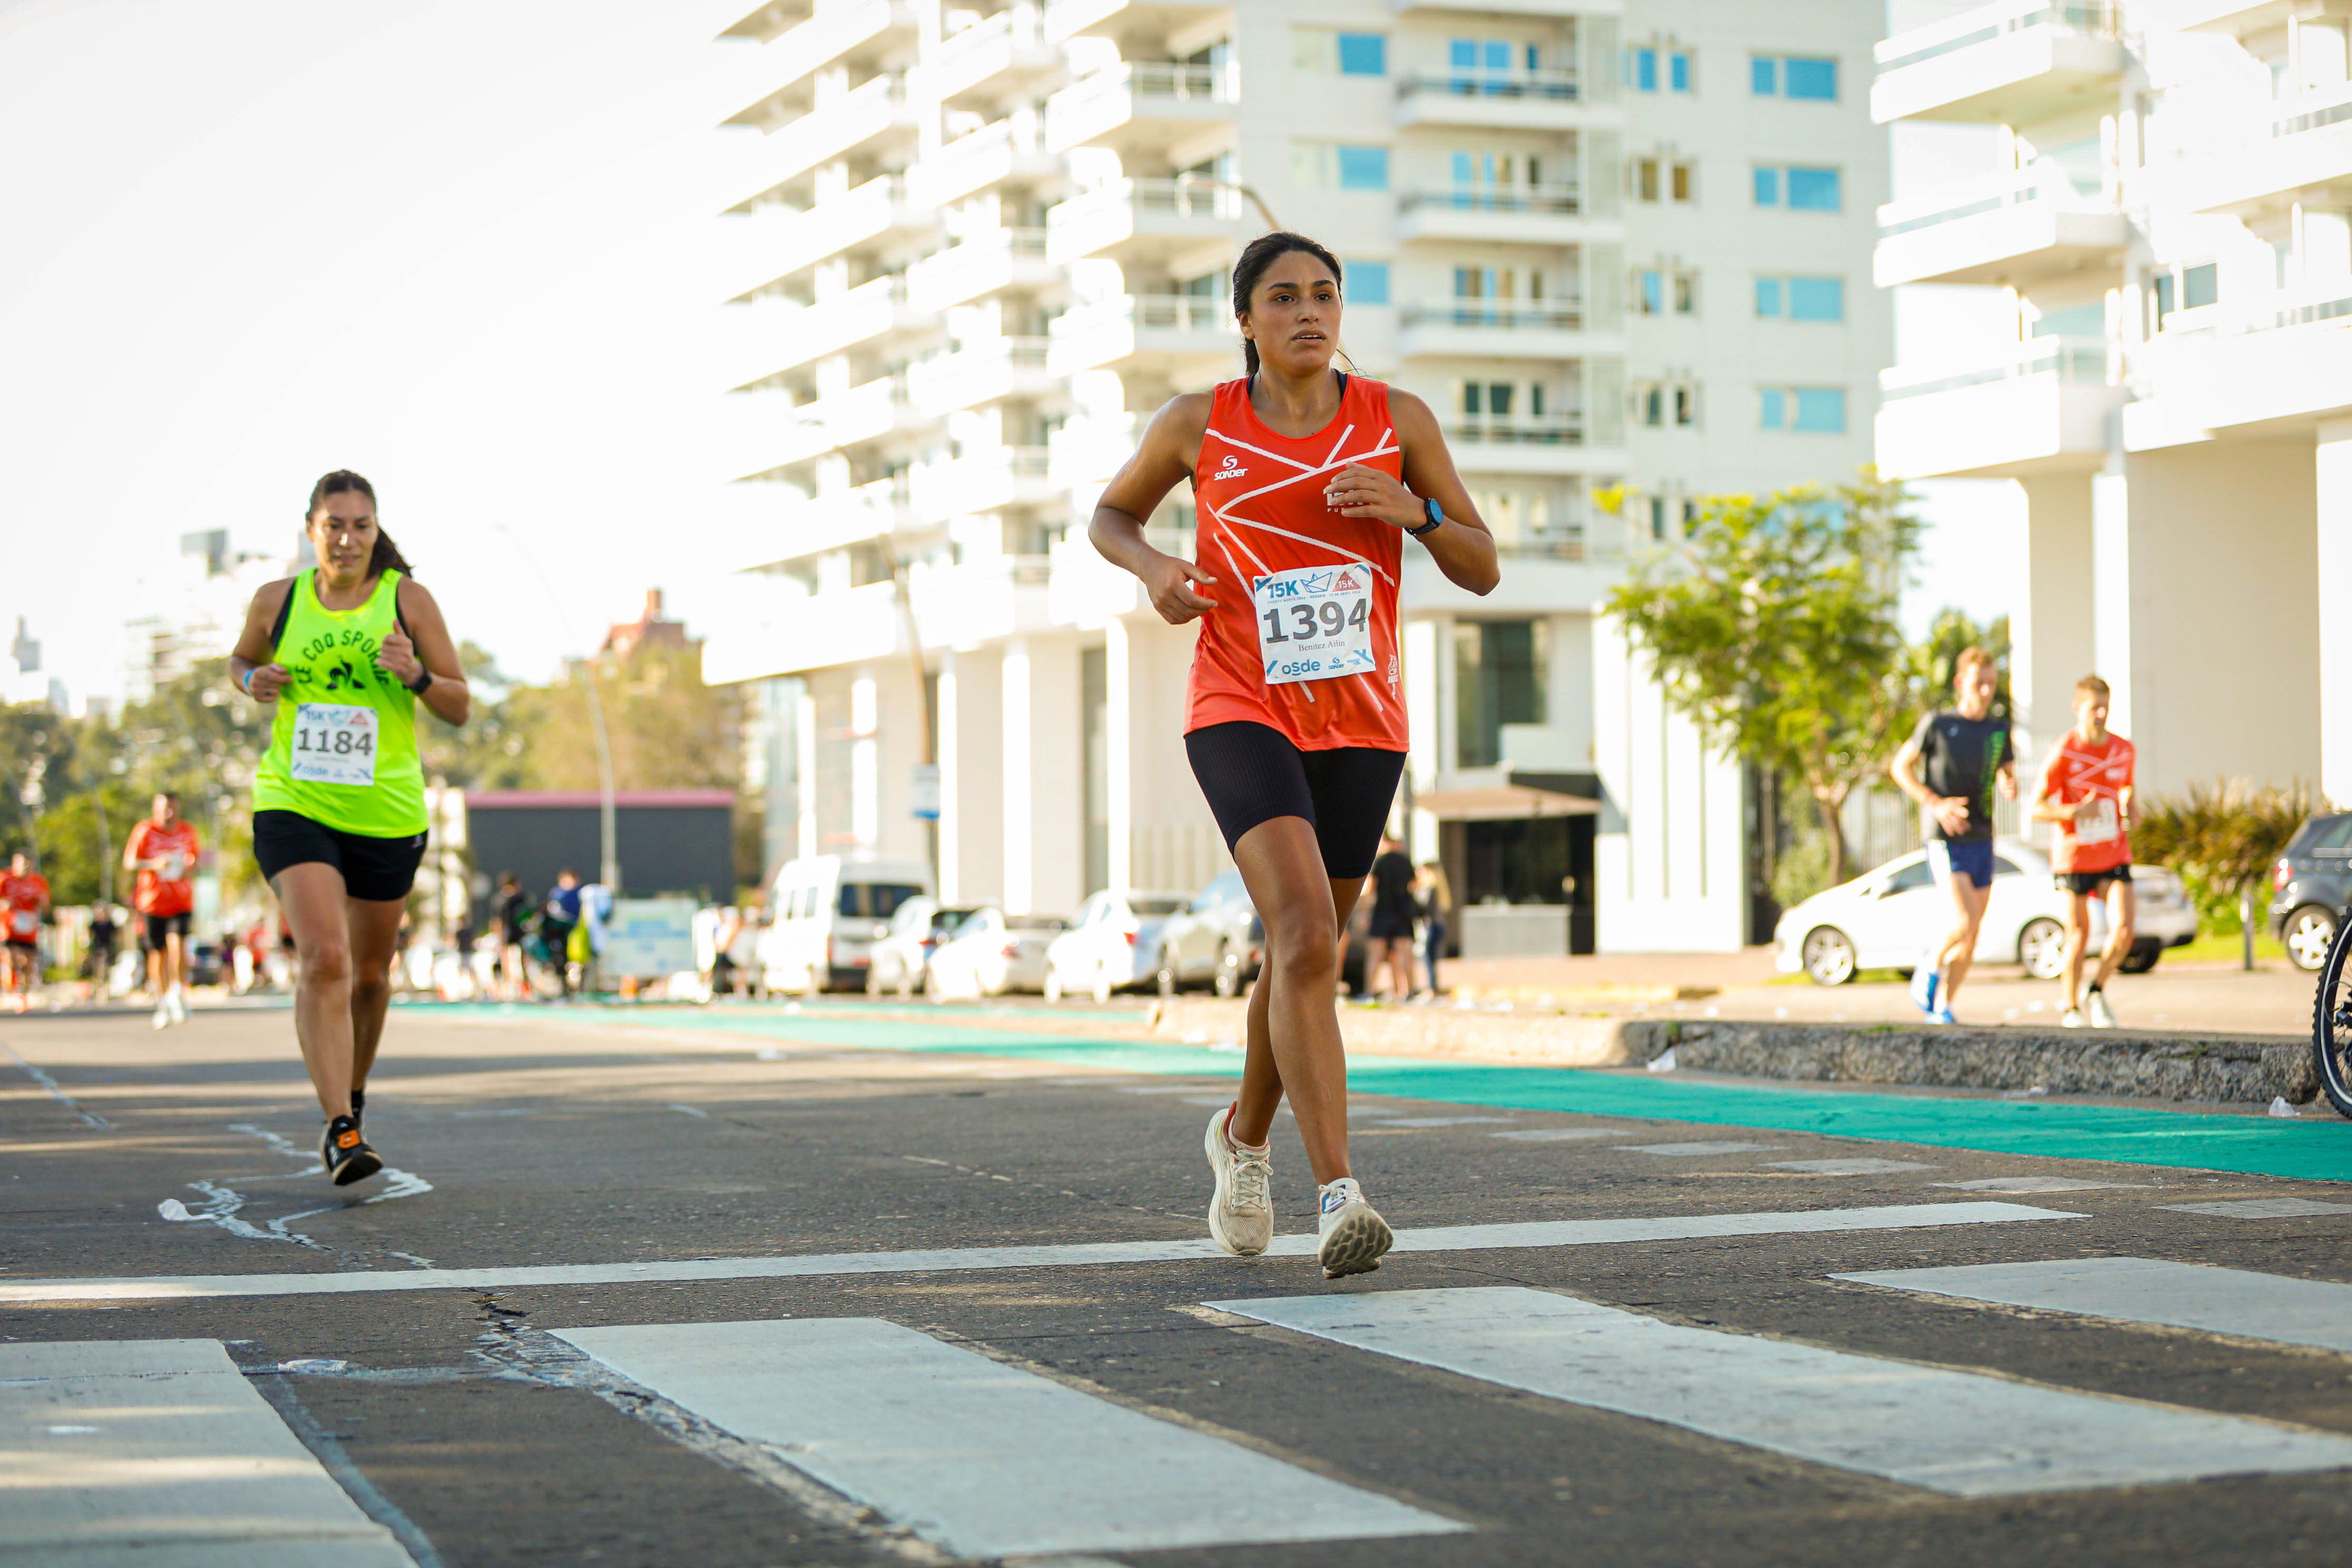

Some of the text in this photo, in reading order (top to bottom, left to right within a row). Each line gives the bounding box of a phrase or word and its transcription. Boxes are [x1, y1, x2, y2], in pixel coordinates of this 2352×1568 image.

[1267, 580, 1299, 599] 15K
[1337, 579, 1355, 589] 15K
[1263, 599, 1366, 644] 1394
[1299, 642, 1326, 652] Benitez
[1282, 659, 1321, 675] osde
[298, 728, 373, 756] 1184
